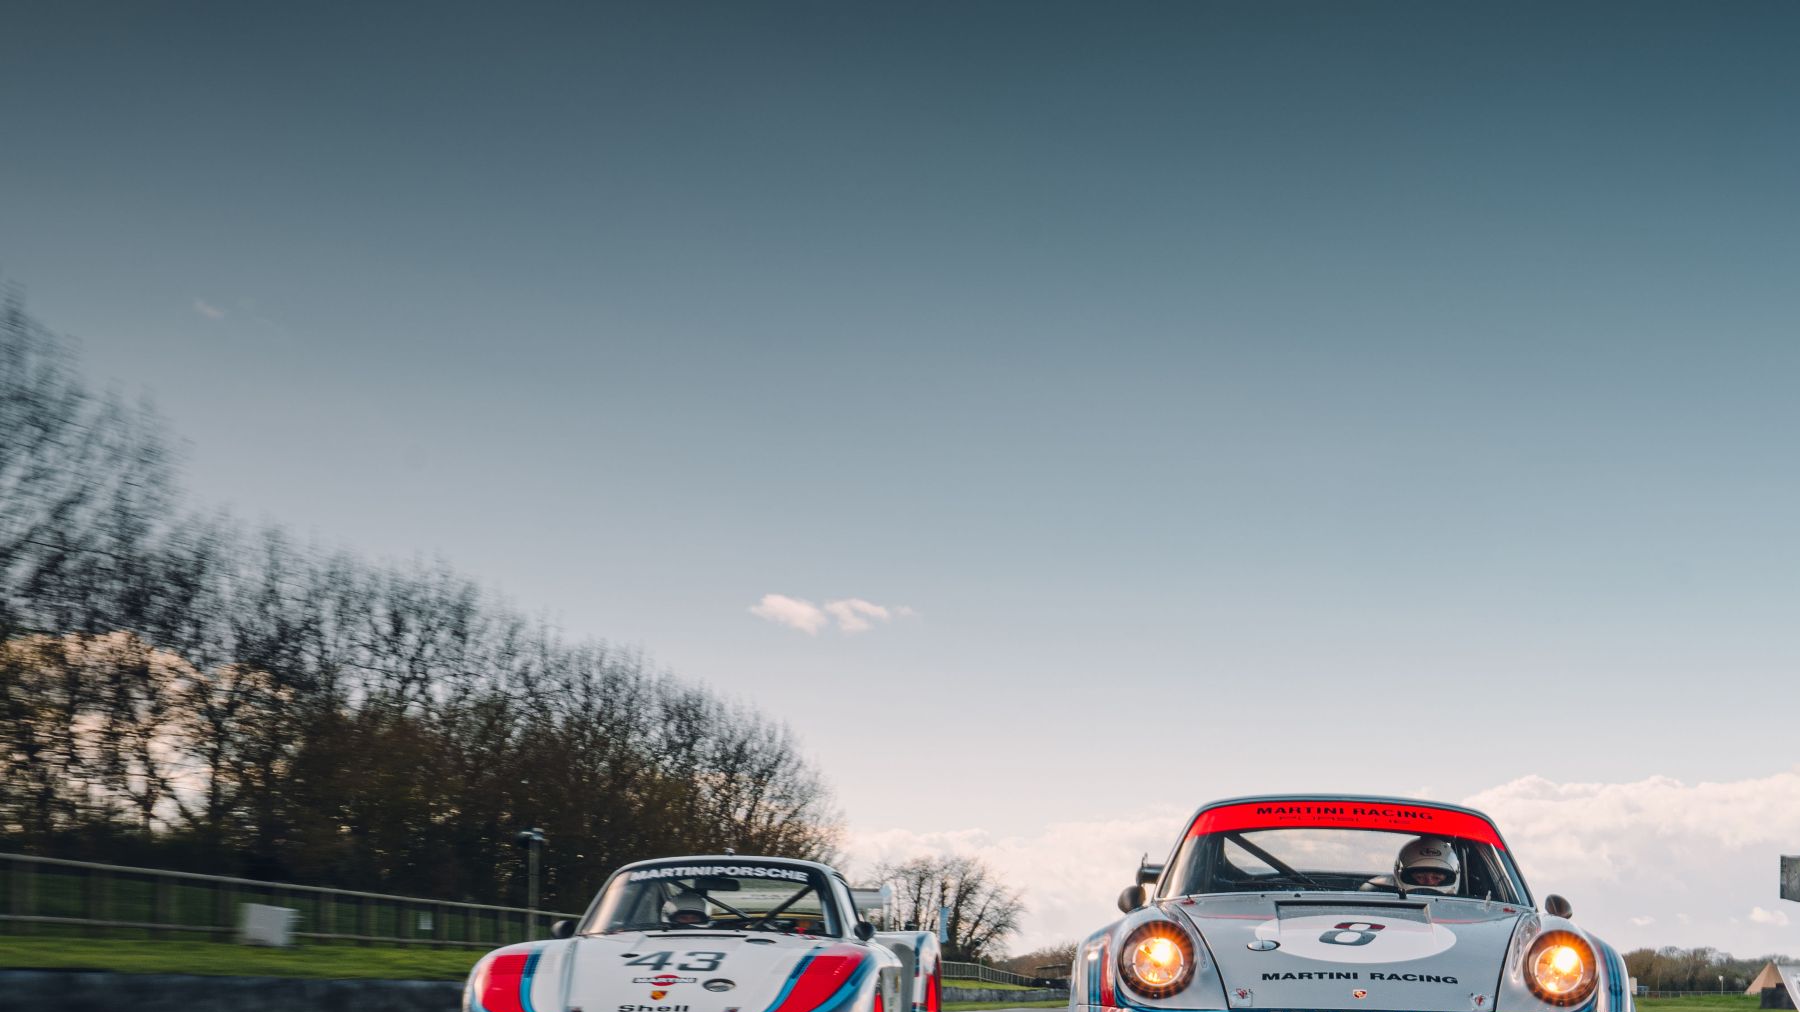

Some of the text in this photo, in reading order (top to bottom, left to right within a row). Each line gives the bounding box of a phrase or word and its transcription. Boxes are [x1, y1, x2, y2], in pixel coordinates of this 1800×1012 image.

[1256, 806, 1344, 815] MARTINI
[1352, 807, 1433, 820] RACING
[1318, 921, 1386, 946] 8
[624, 951, 727, 972] 43
[1261, 971, 1459, 984] MARTINI RACING
[618, 1004, 689, 1012] Shell
